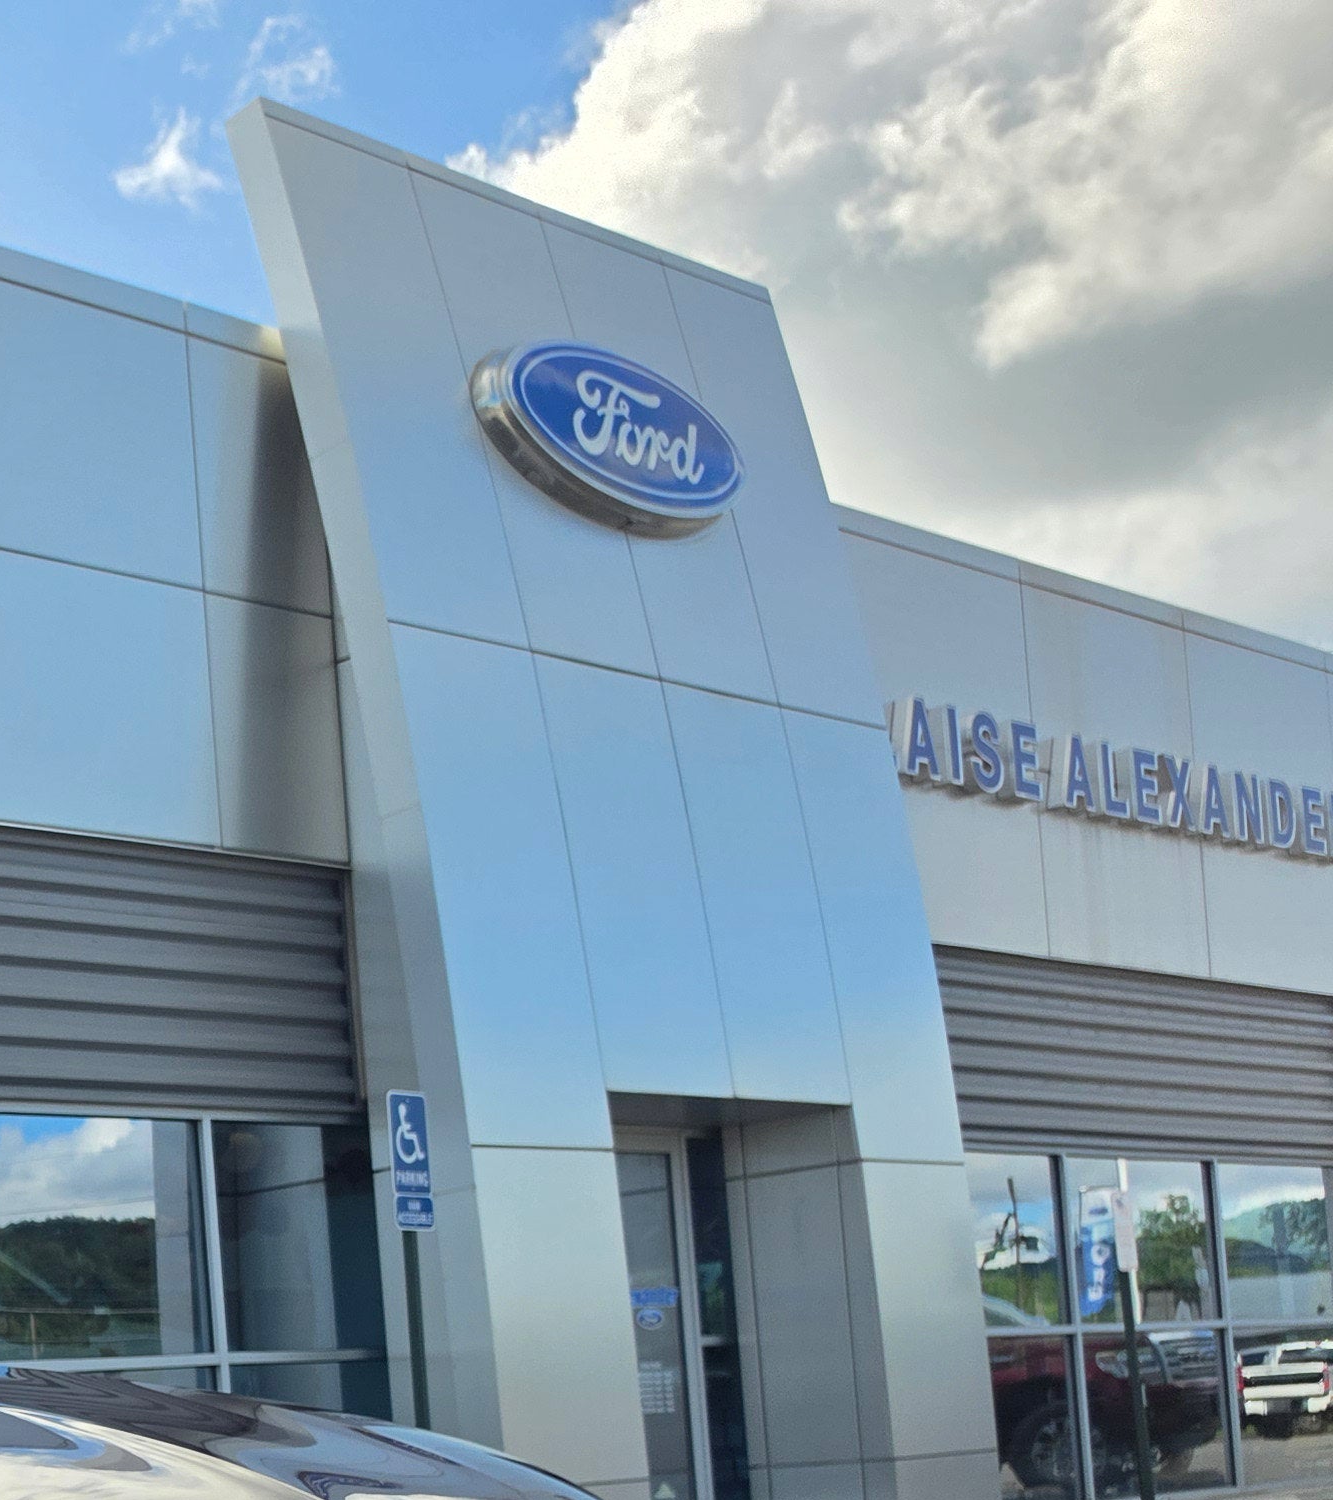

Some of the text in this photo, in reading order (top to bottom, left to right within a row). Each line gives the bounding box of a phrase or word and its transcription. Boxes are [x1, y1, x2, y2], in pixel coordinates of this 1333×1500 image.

[573, 369, 705, 485] Ford
[890, 697, 1333, 866] AISE ALEXANDE
